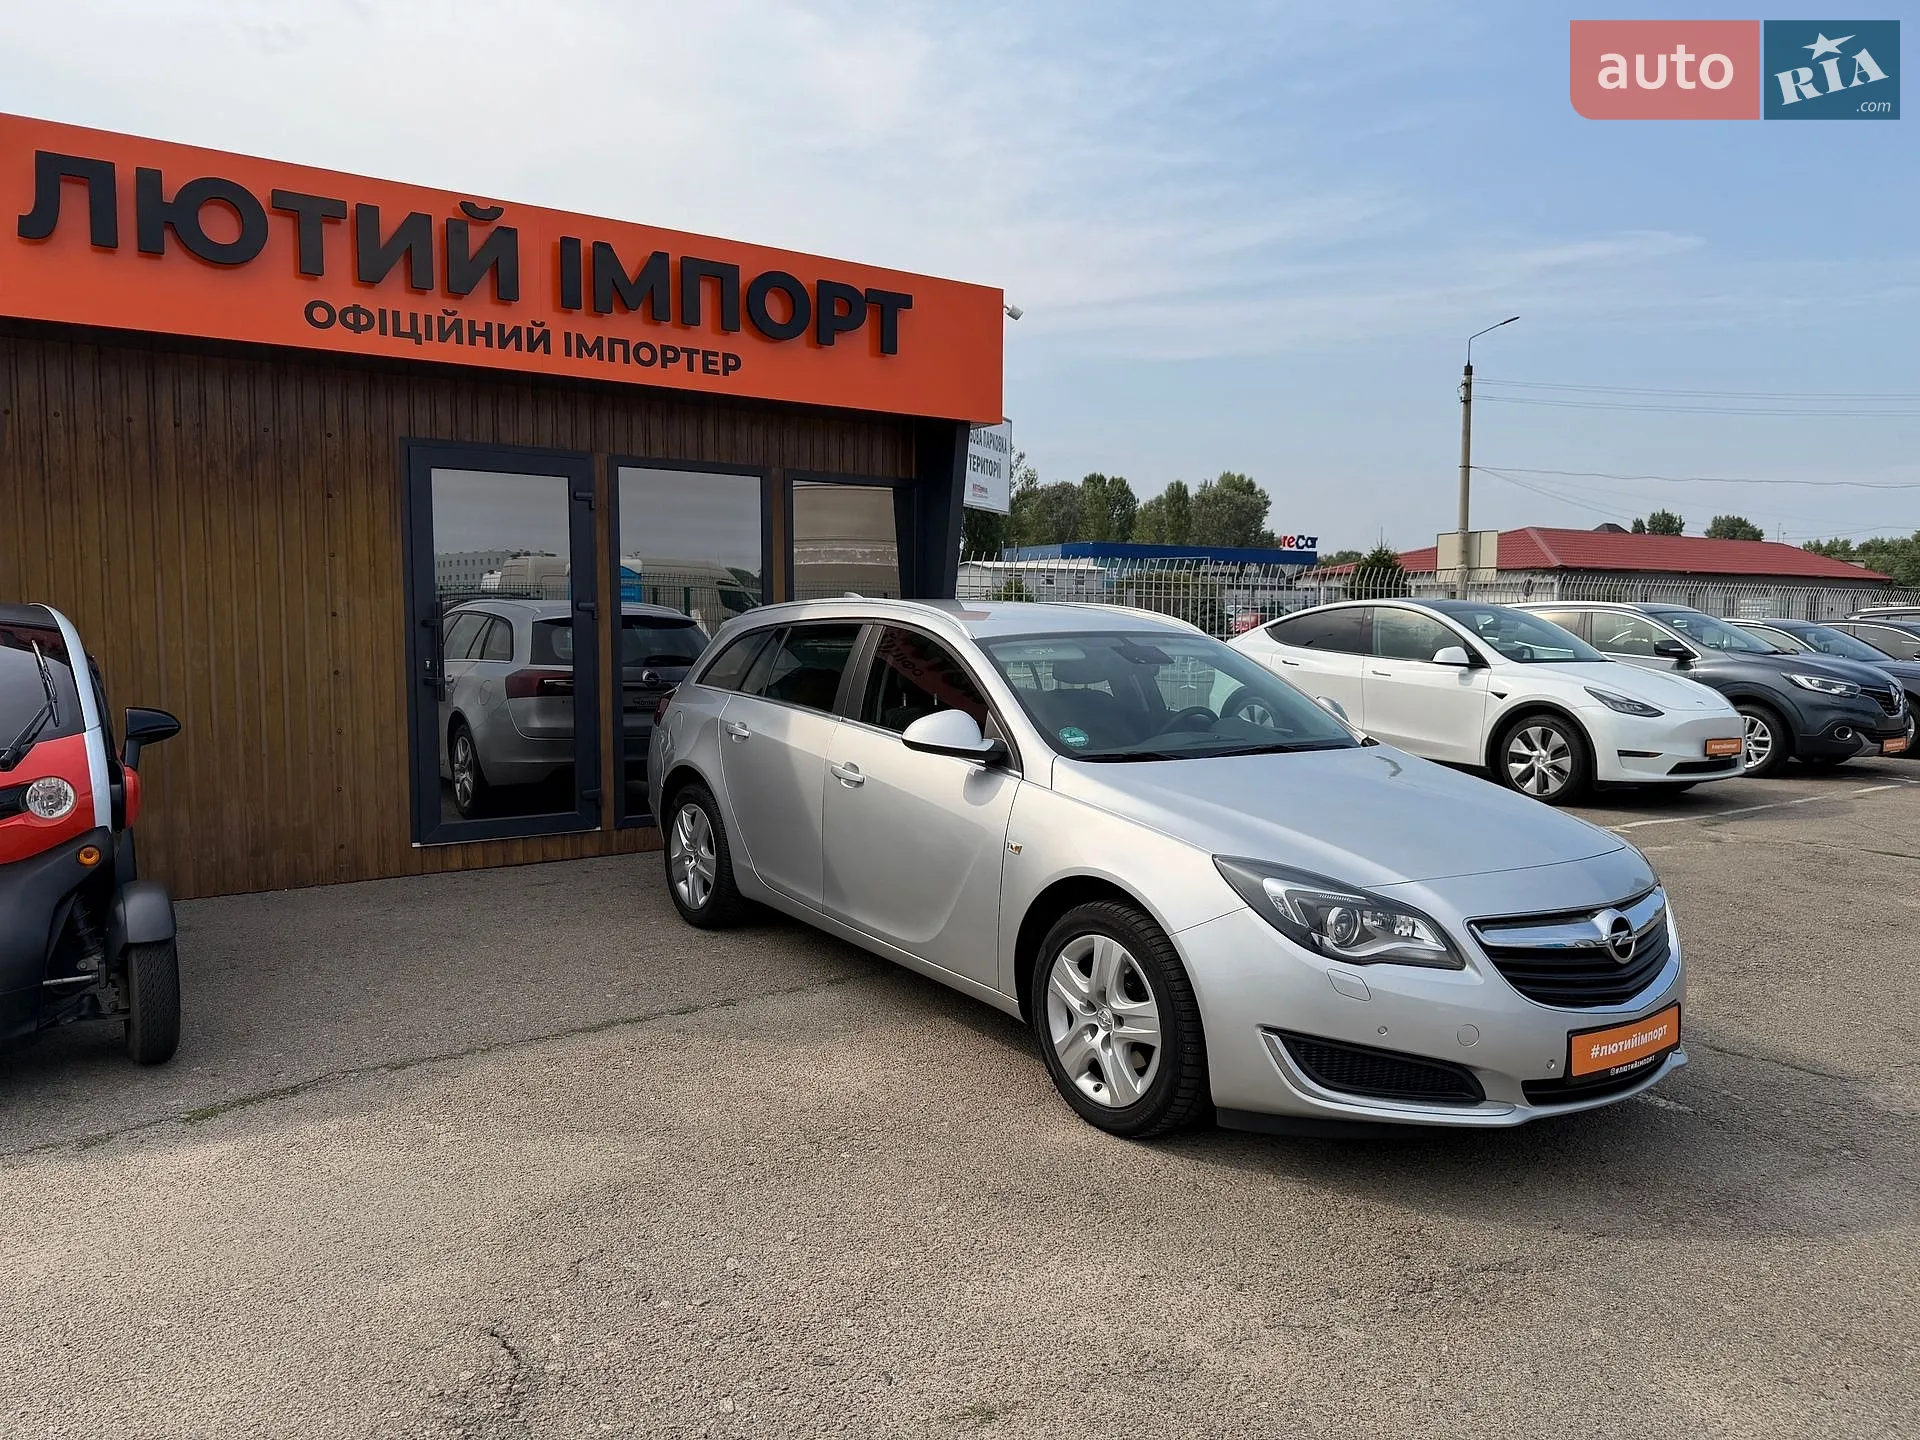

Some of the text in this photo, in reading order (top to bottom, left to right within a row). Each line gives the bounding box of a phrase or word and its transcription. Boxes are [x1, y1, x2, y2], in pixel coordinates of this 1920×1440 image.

[17, 150, 914, 355] ЛЮТИЙ ІМПОРТ
[304, 300, 742, 378] ОФІЦІЙНИЙ ІМПОРТЕР
[1590, 1024, 1668, 1059] #лютийімпорт
